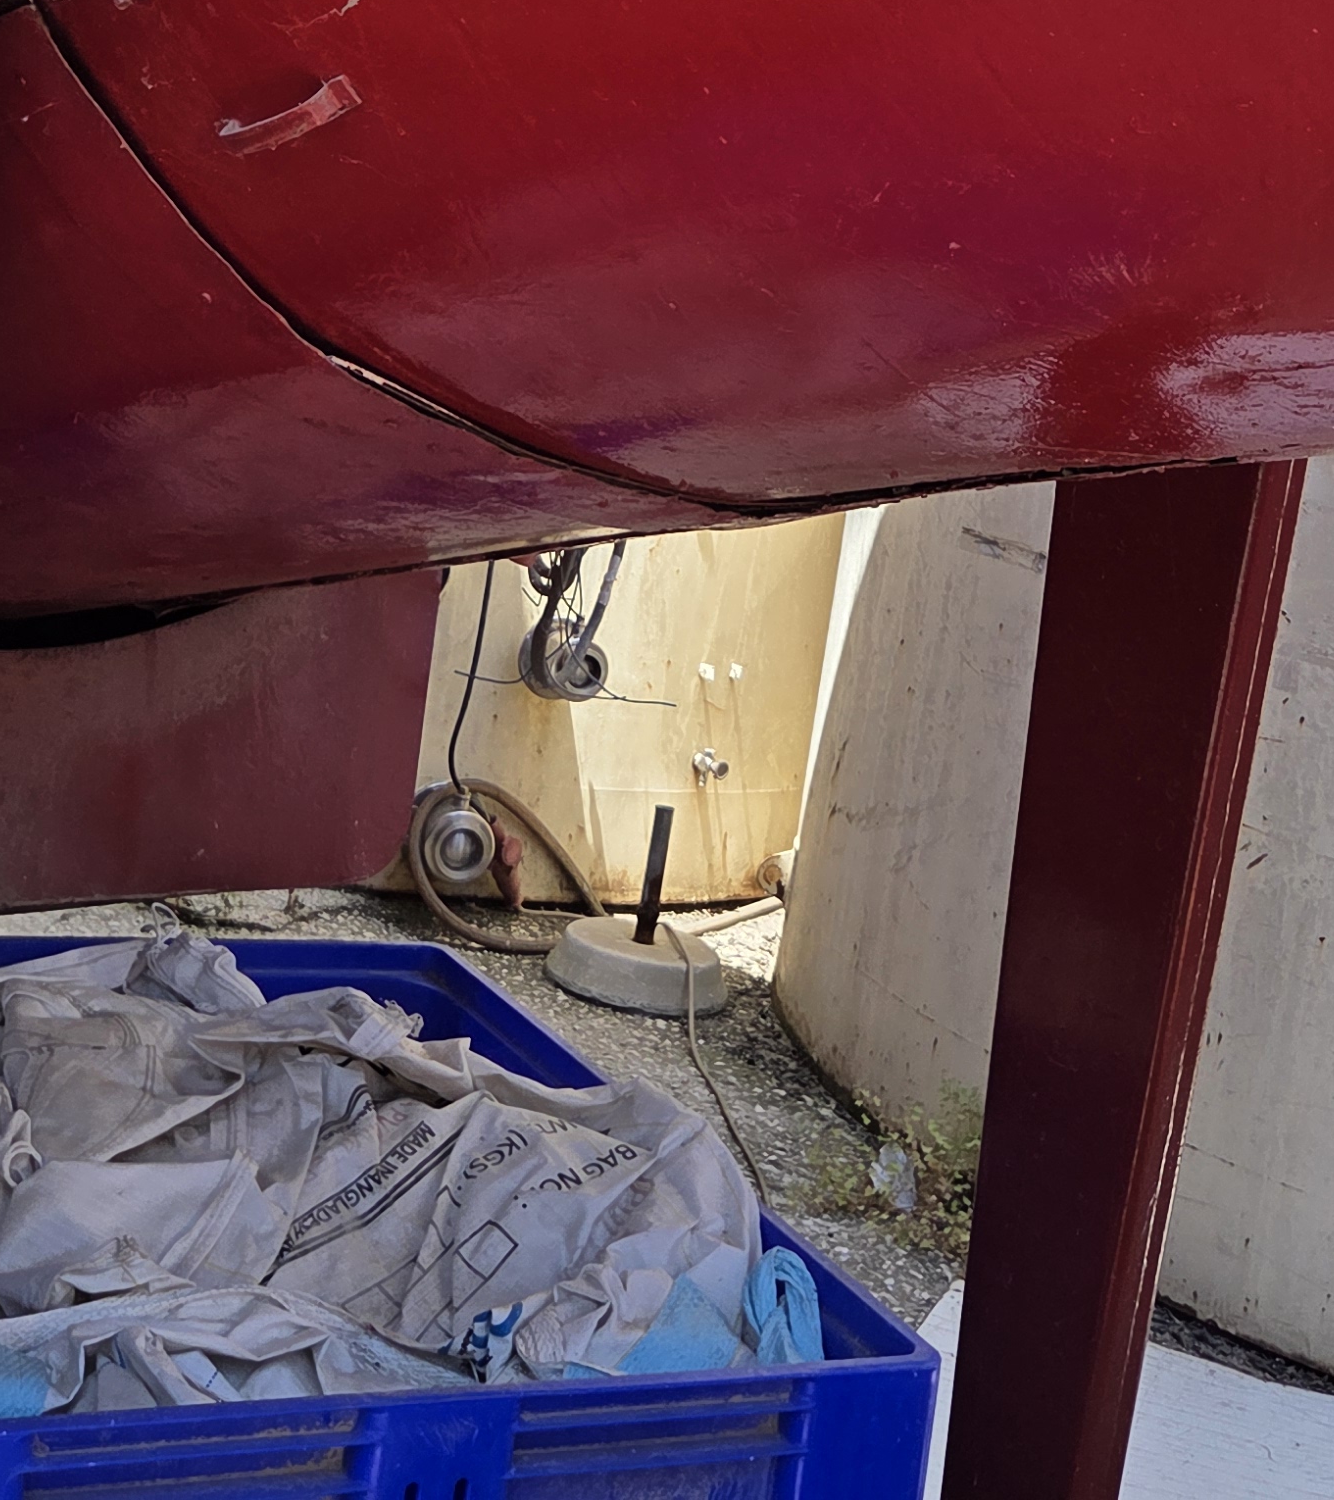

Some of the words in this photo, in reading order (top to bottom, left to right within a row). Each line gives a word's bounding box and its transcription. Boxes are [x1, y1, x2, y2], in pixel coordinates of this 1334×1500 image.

[390, 1120, 436, 1164] MADE
[581, 1143, 638, 1178] BAG
[291, 1172, 383, 1242] ANGLADESH
